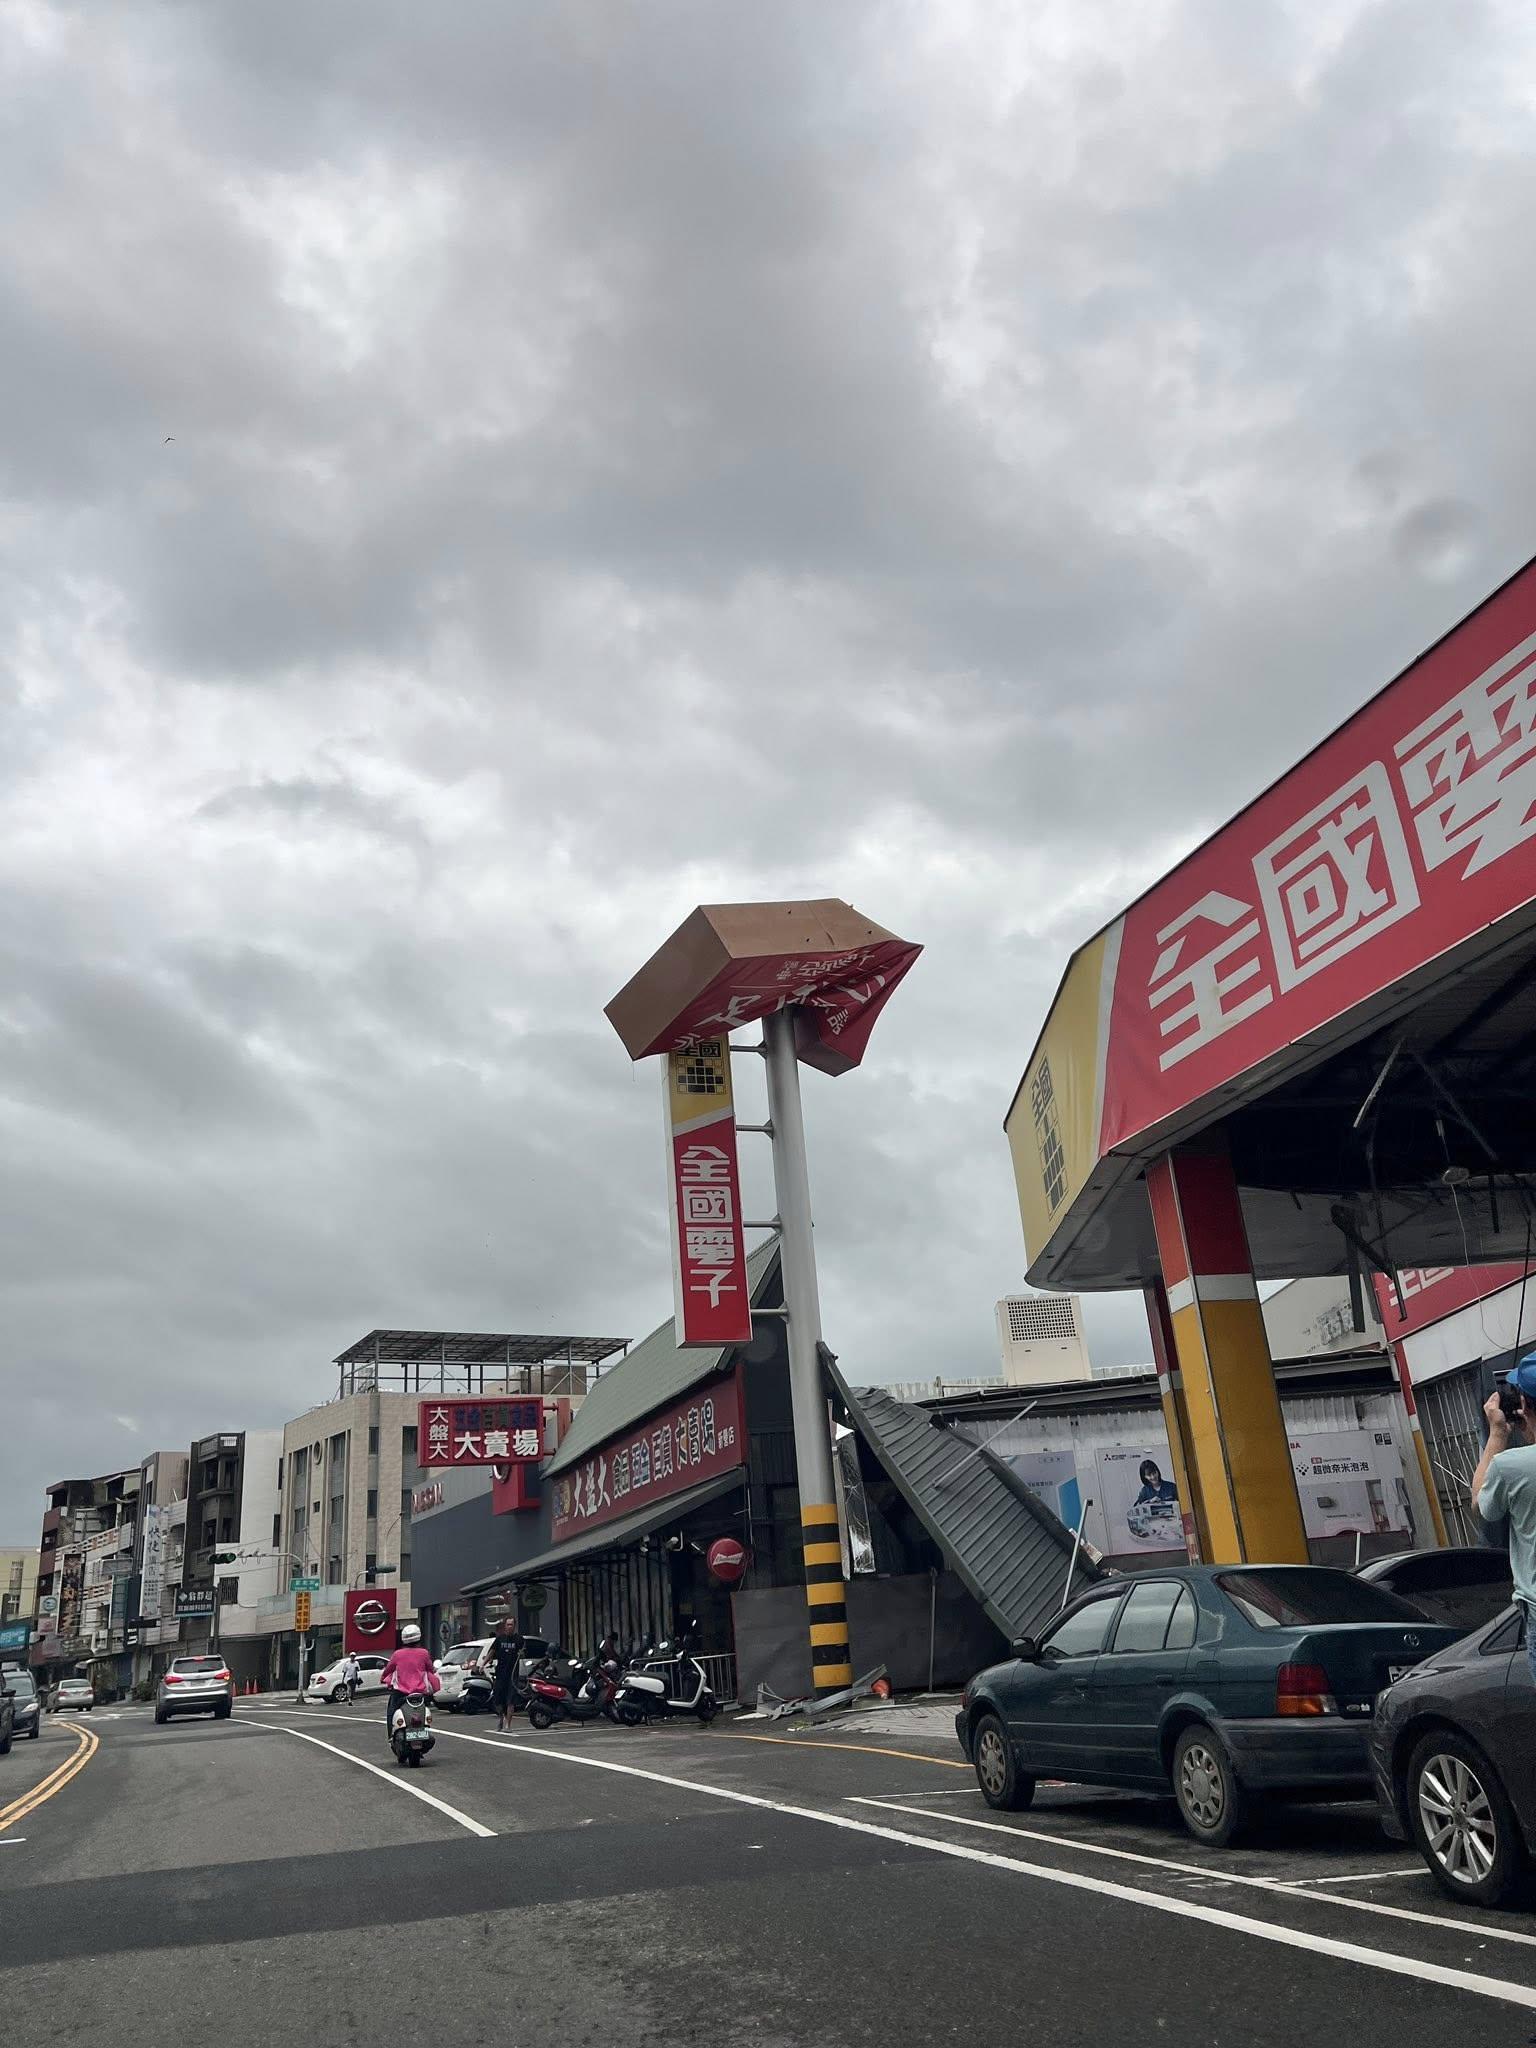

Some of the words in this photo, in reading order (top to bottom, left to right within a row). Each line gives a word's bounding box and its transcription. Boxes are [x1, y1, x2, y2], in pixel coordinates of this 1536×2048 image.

[679, 1145, 737, 1308] 全國電子
[429, 1406, 448, 1459] 大盤大
[454, 1429, 539, 1459] 大賣場
[1313, 1461, 1369, 1475] 超微奈米泡泡
